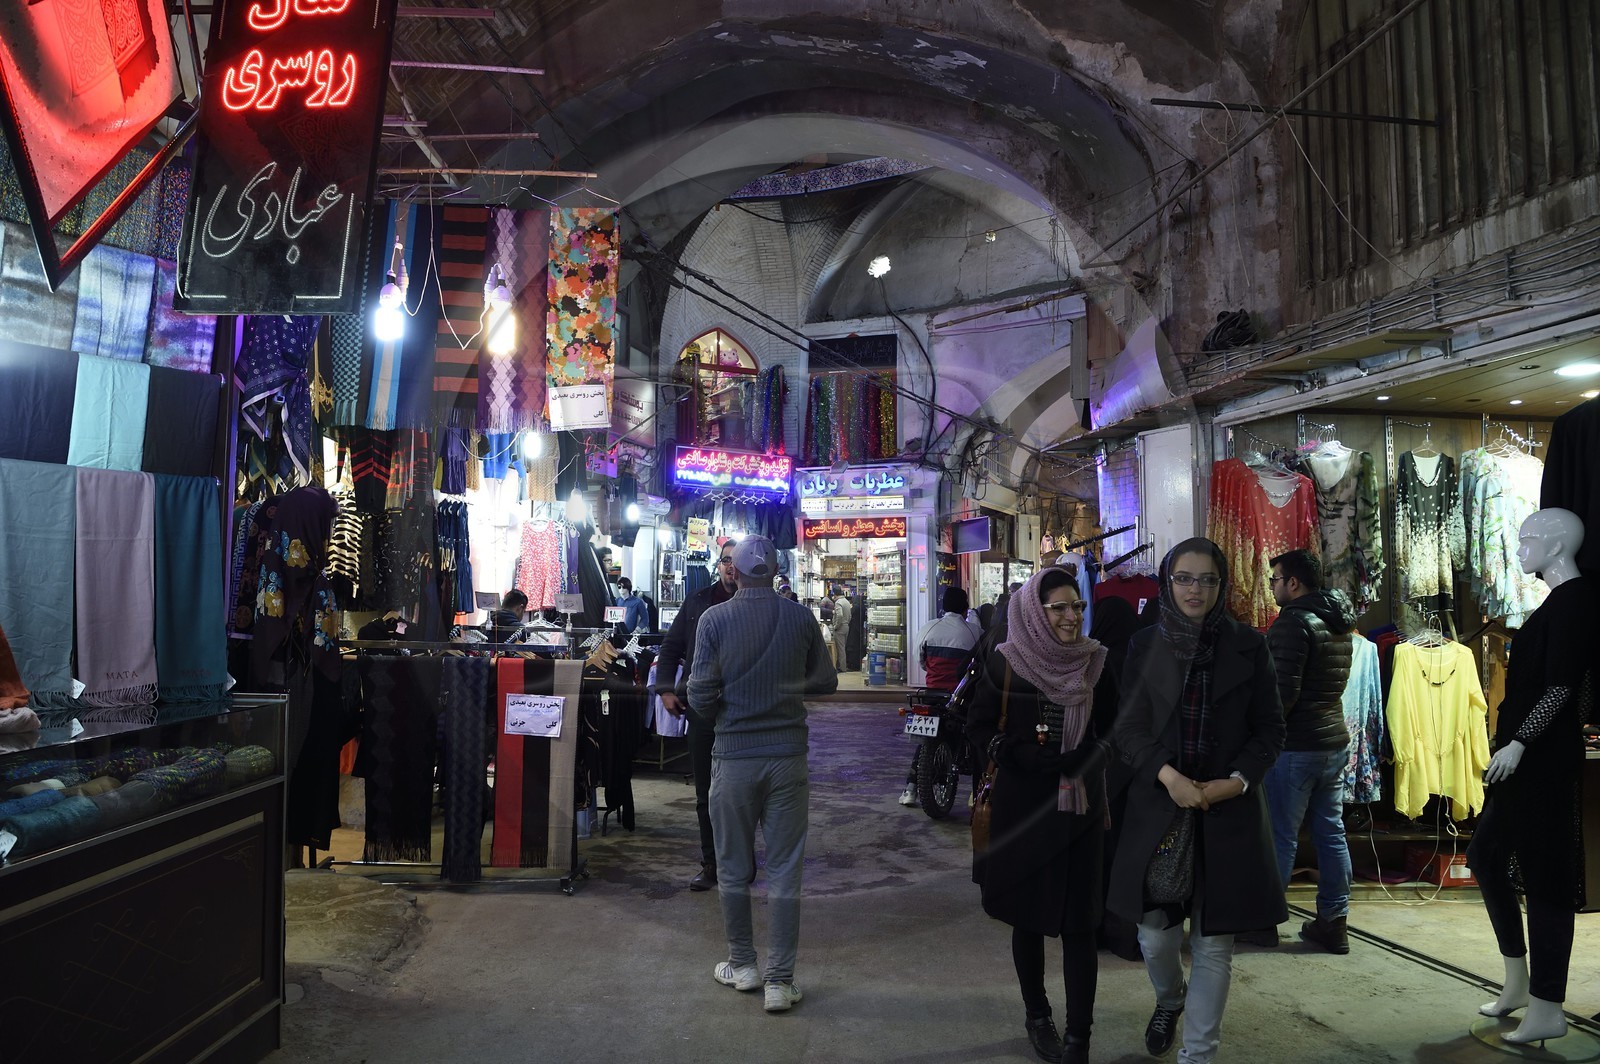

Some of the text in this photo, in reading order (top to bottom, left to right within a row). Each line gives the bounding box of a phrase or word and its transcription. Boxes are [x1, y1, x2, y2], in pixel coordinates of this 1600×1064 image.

[222, 49, 356, 110] روسری
[202, 161, 343, 264] عبادی
[849, 472, 905, 494] عطریات
[806, 519, 842, 537] اسانس
[850, 518, 874, 536] عطر
[875, 518, 905, 536] پخش
[106, 670, 139, 680] MATA
[546, 721, 557, 729] کلی
